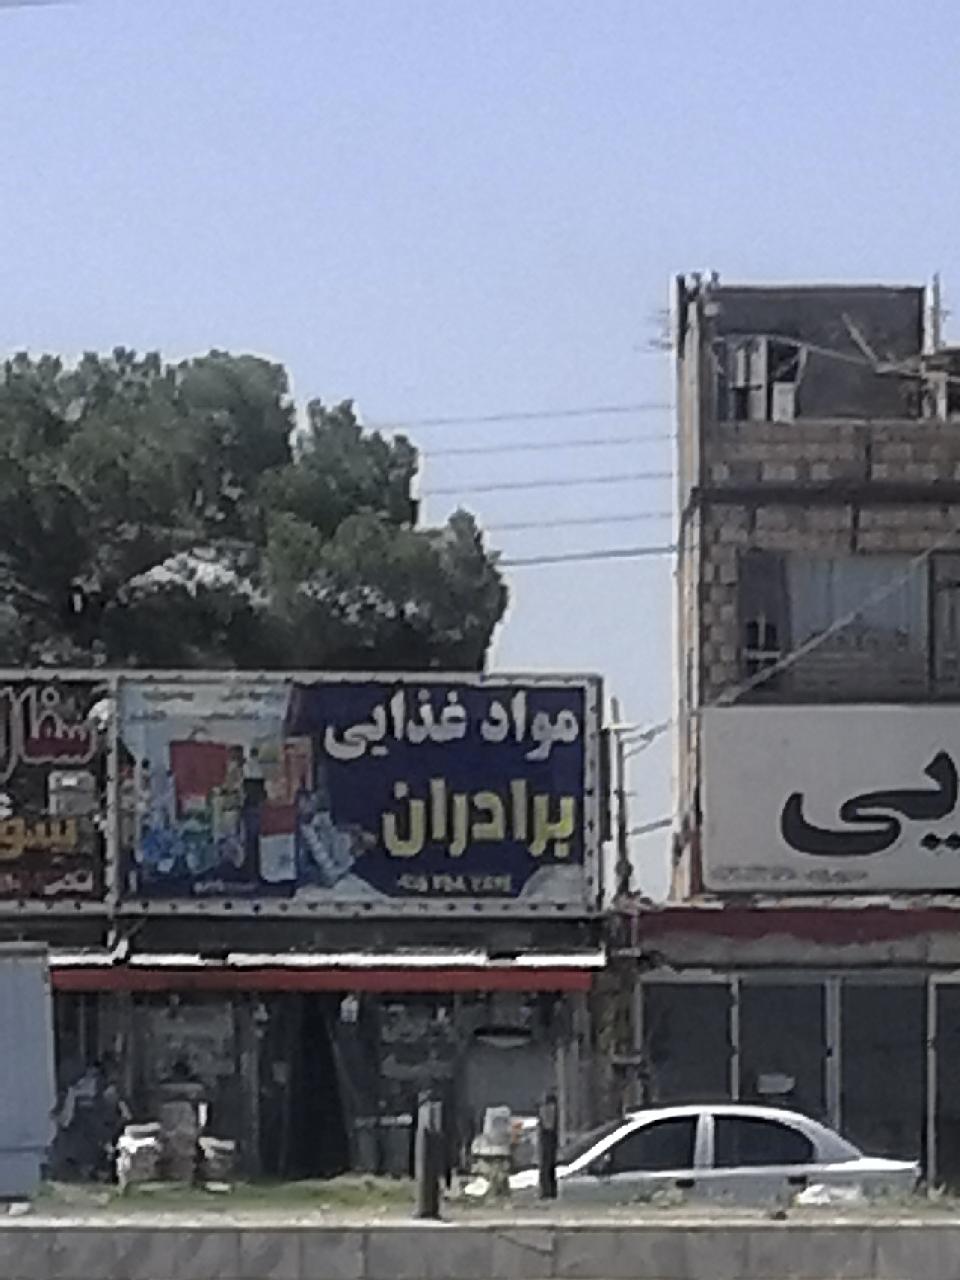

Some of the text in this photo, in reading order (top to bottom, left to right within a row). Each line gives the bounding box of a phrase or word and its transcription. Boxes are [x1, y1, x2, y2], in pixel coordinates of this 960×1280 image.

[325, 688, 579, 760] مواد غذایی
[382, 778, 576, 858] برادران
